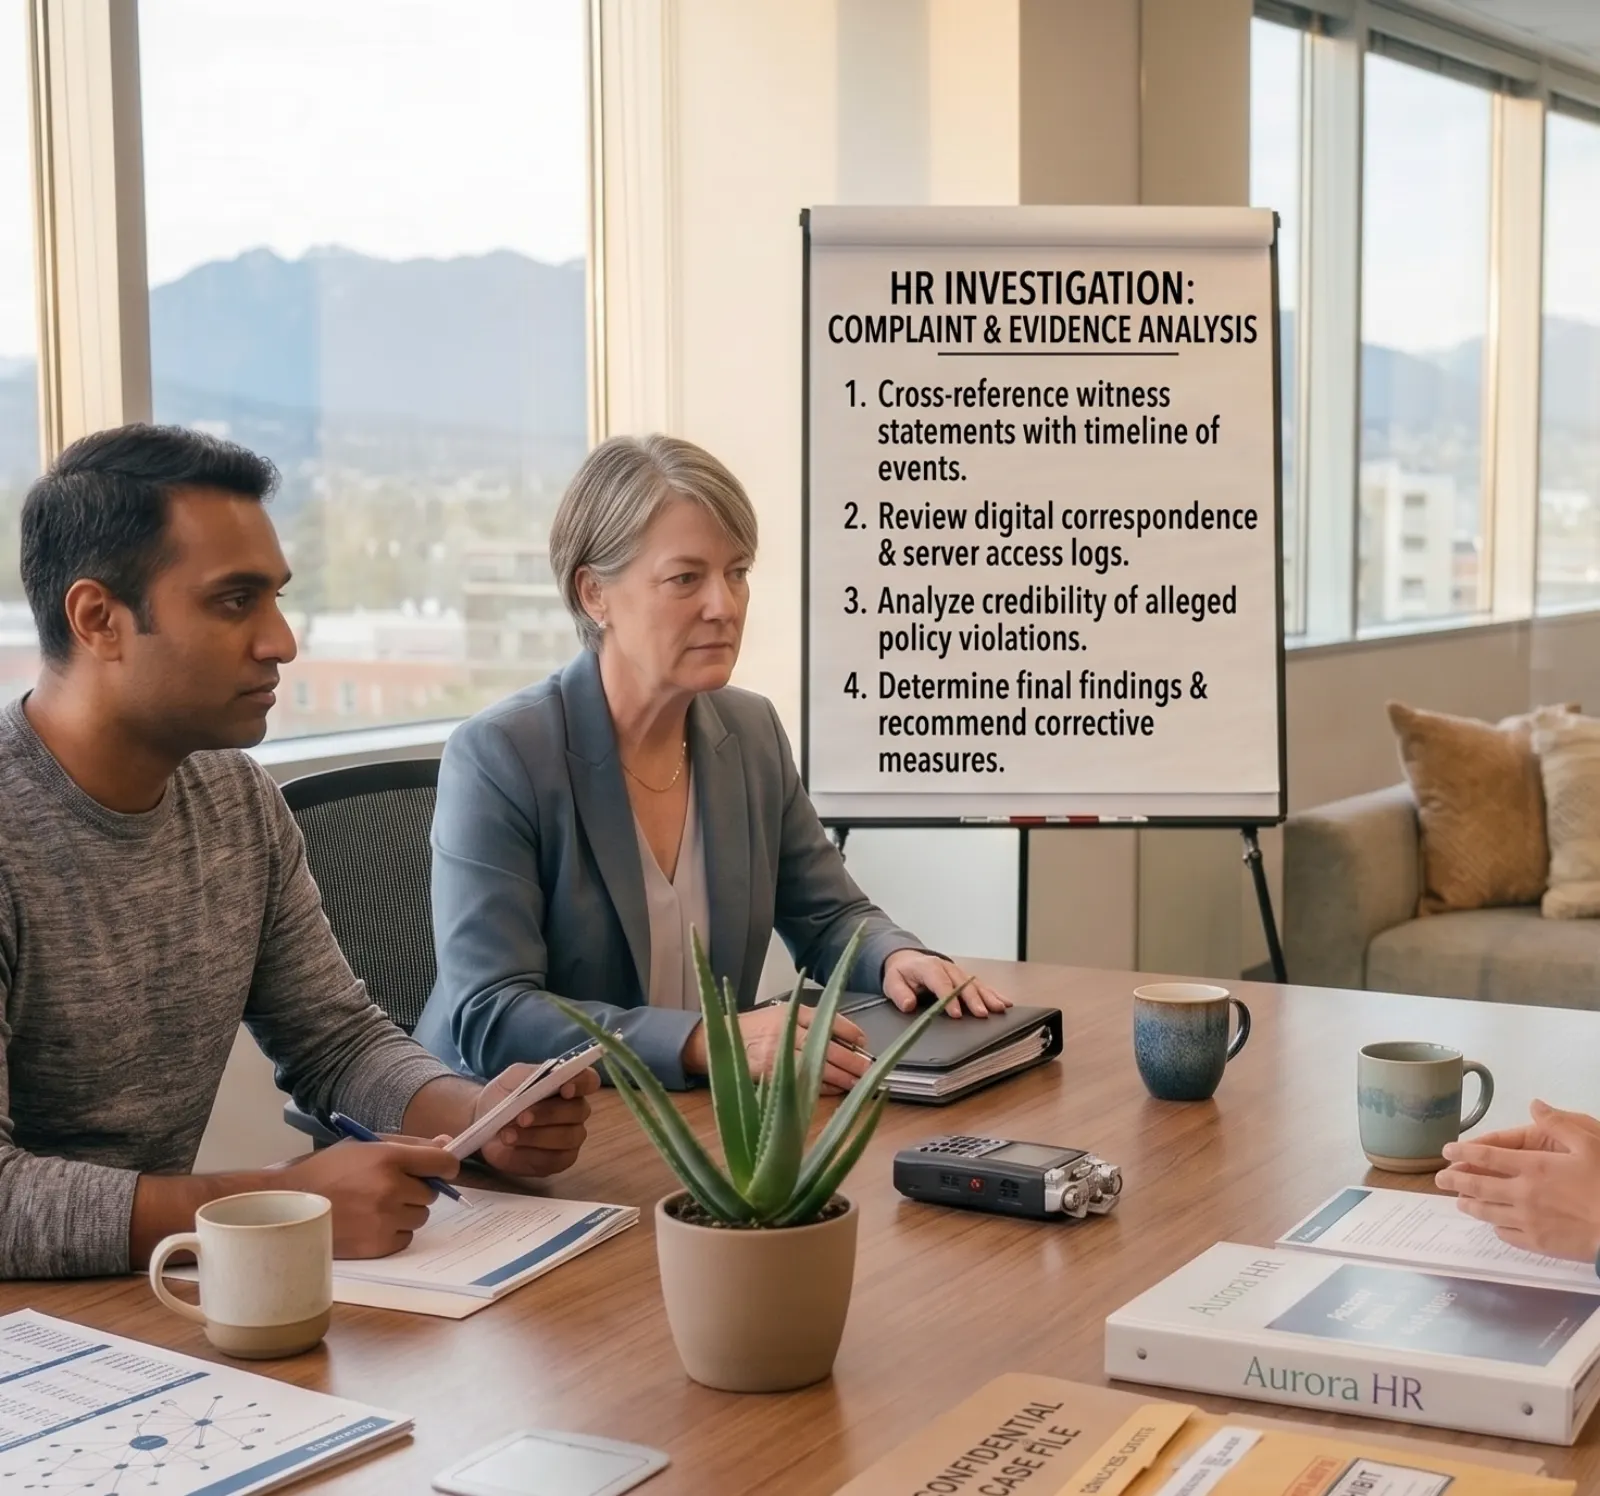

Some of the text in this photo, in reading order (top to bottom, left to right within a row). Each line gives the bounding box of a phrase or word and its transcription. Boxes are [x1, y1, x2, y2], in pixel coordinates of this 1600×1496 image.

[891, 269, 1194, 306] HR INVESTIGATION:
[828, 314, 1258, 344] COMPLAINT & EVIDENCE ANALYSIS
[845, 377, 1171, 408] 1. Cross-reference witness
[877, 414, 1221, 445] statements with timeline of
[878, 455, 967, 482] events.
[844, 499, 1258, 539] 2. Review digital correspondence
[878, 537, 1129, 575] & server access logs.
[843, 584, 1237, 623] 3. Analyze credibility of alleged
[879, 622, 1087, 660] policy violations.
[843, 669, 1208, 708] 4. Determine final findings &
[879, 706, 1155, 737] recommend corrective
[879, 751, 1005, 773] measures.
[1188, 1260, 1285, 1317] Aurora HR
[1243, 1356, 1425, 1411] Aurora HR
[978, 1456, 1046, 1496] CASE
[1024, 1425, 1082, 1457] FILE
